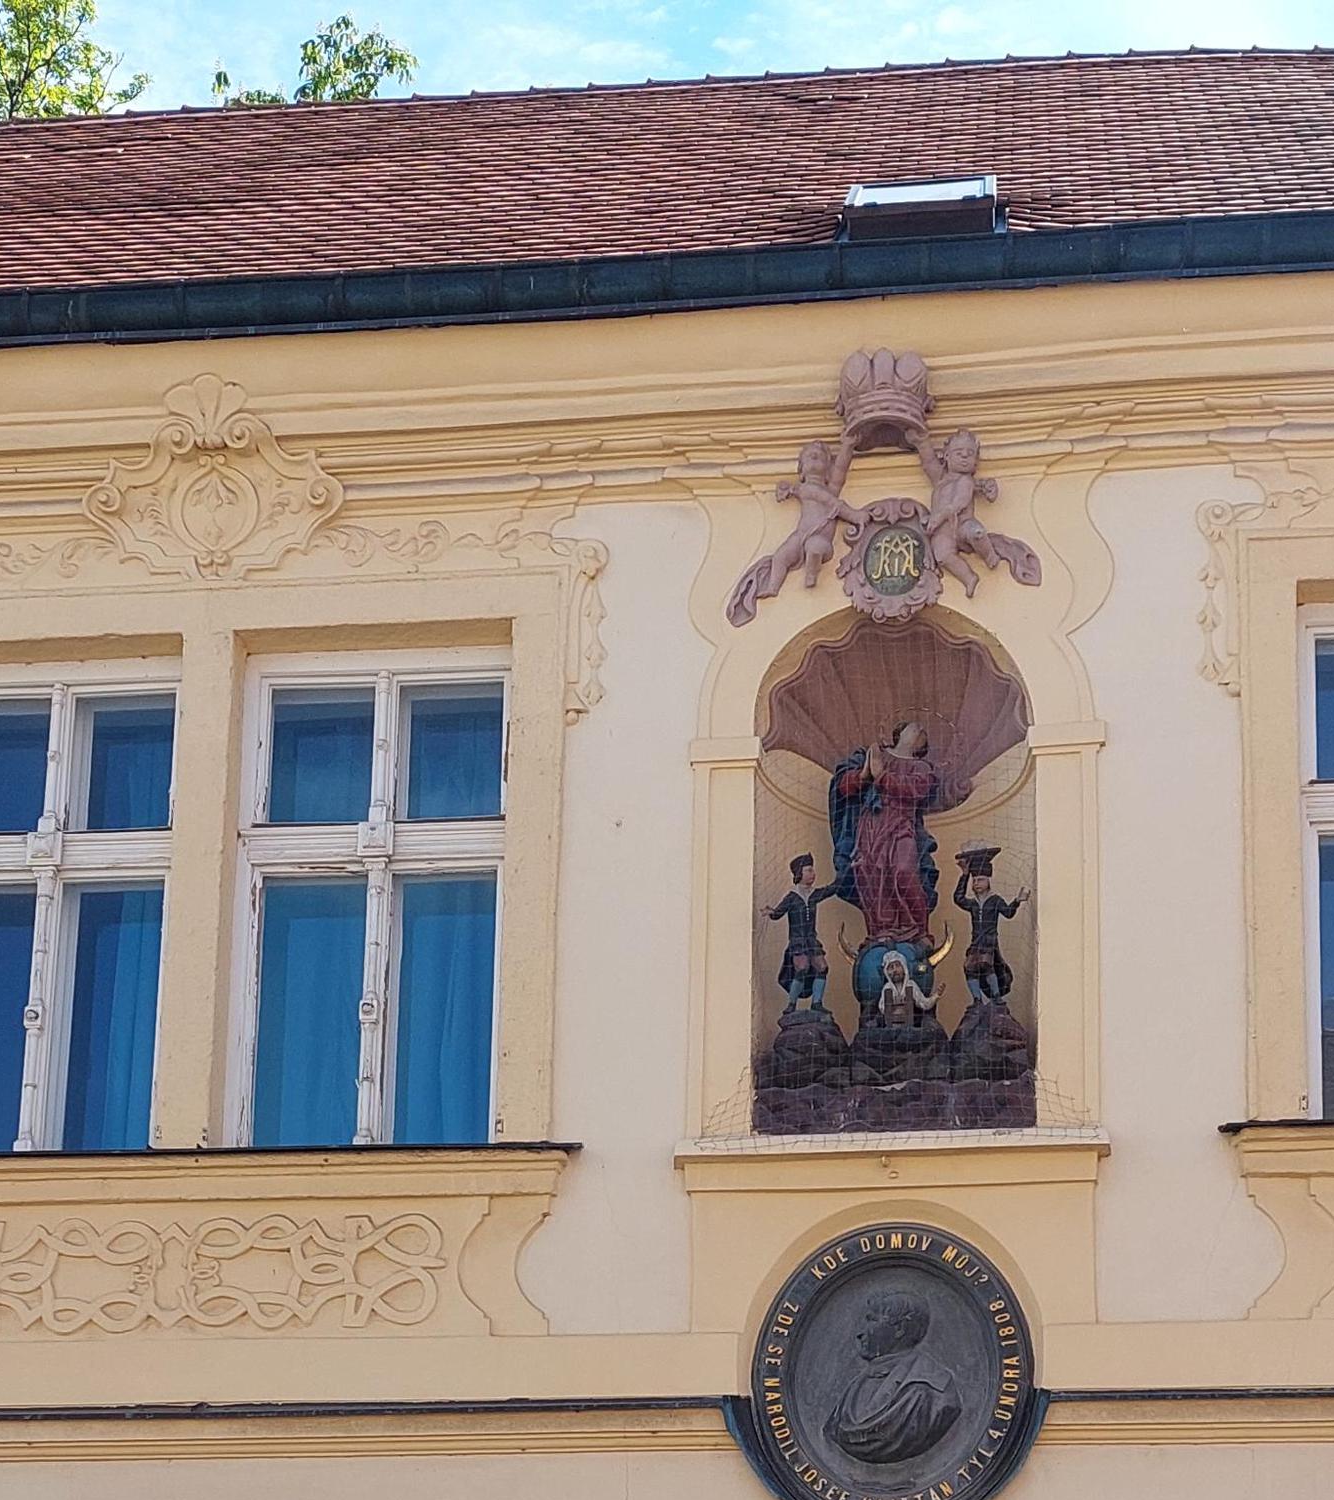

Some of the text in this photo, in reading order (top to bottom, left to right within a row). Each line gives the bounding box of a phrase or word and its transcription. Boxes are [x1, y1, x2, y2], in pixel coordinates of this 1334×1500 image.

[811, 1247, 848, 1280] KDE
[860, 1233, 932, 1252] DOMOV
[772, 1301, 799, 1337] ZDE
[765, 1344, 784, 1367] SE
[763, 1377, 798, 1460] NARODIL
[957, 1447, 995, 1481] TYL
